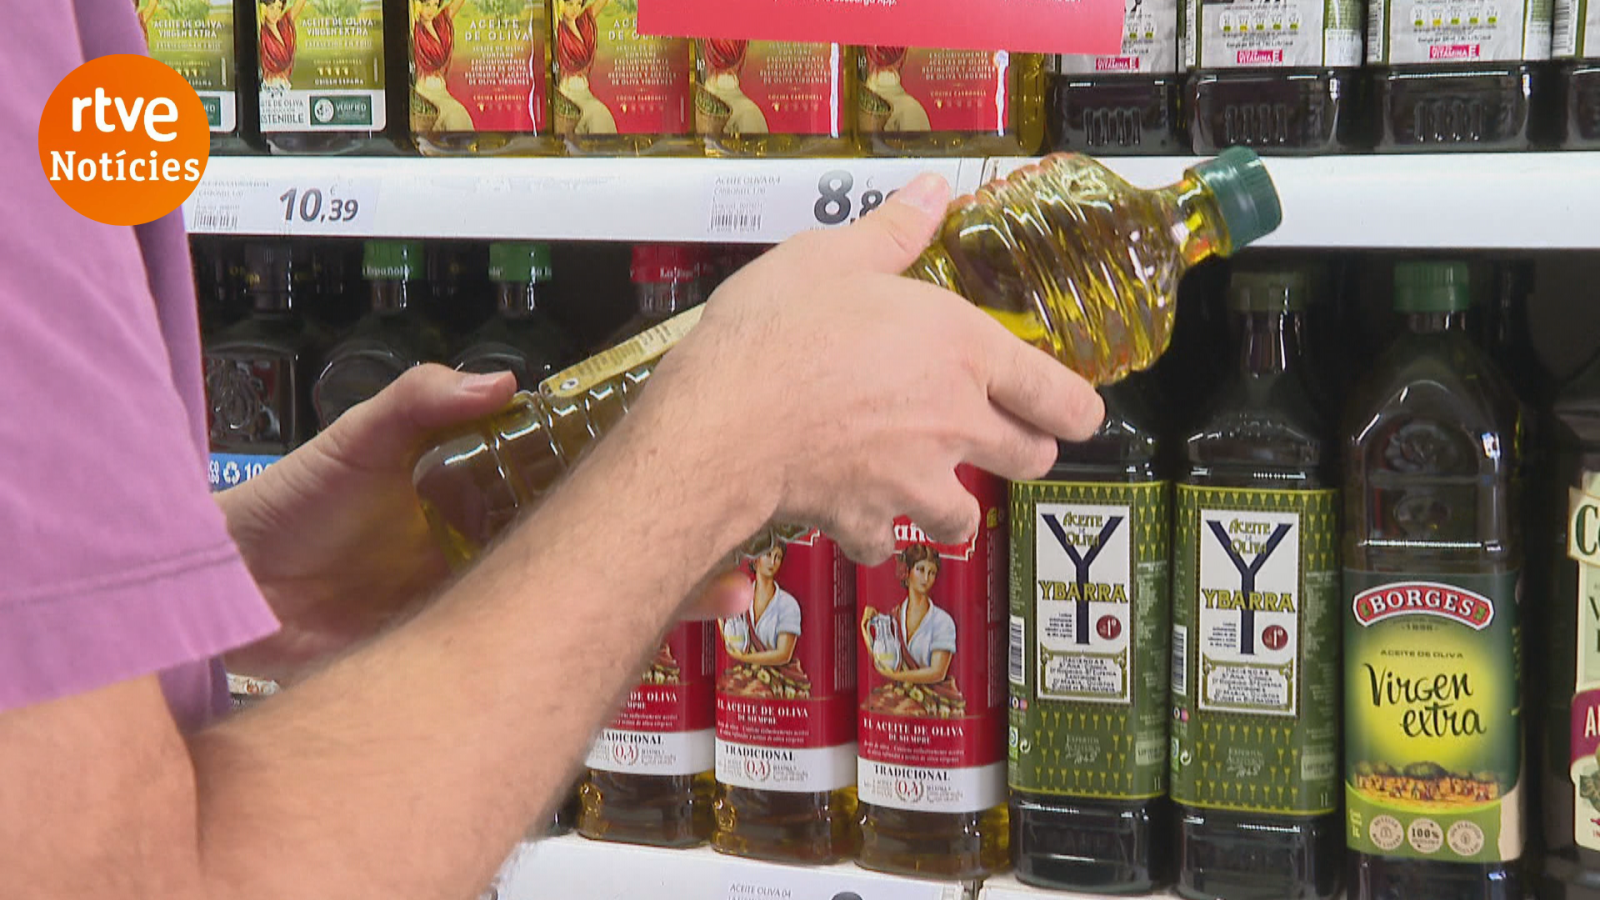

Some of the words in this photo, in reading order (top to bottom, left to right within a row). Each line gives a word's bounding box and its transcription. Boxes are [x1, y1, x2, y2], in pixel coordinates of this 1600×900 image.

[470, 19, 519, 30] ACEITE
[465, 31, 481, 41] DE
[488, 30, 529, 41] OLIVA
[608, 30, 624, 40] DE
[279, 187, 360, 224] 10,39
[813, 169, 901, 226] 8,8
[1038, 580, 1128, 603] YBARRA
[1202, 588, 1296, 613] YBARRA
[1369, 589, 1475, 617] BORGES
[647, 691, 678, 702] OLIVA
[726, 700, 759, 714] ACEITE
[761, 704, 774, 716] DE
[778, 706, 808, 718] OLIVA
[875, 720, 910, 734] ACEITE
[914, 725, 927, 735] DE
[931, 725, 964, 736] OLIVA
[1399, 701, 1487, 738] extra
[725, 744, 796, 761] TRADICIONAL
[874, 764, 950, 782] TRADICIONAL
[730, 883, 756, 894] ACEITE
[757, 886, 780, 898] OLIVA
